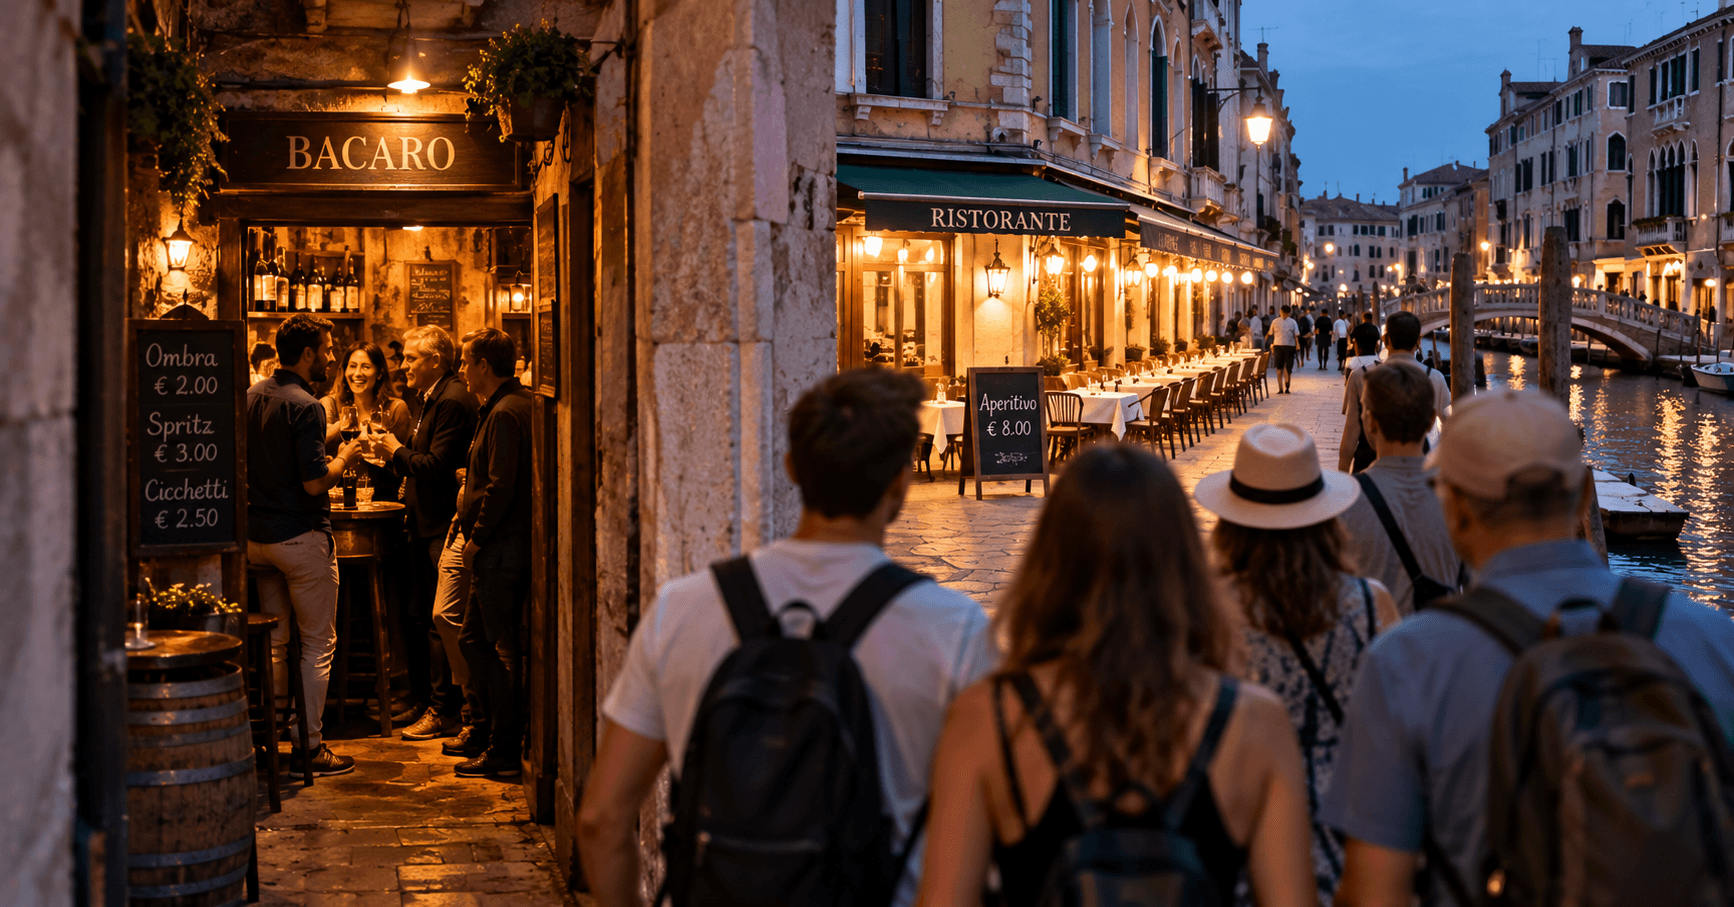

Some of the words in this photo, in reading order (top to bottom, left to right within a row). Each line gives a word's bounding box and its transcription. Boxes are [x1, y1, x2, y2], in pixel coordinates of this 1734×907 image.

[286, 135, 456, 171] BACARO
[930, 207, 1072, 233] RISTORANTE
[145, 342, 219, 368] Ombra
[153, 375, 169, 396] €
[175, 375, 218, 395] 2.00
[979, 393, 1037, 417] Aperitivo
[146, 411, 215, 443] Spritz
[986, 420, 997, 437] €
[1001, 419, 1032, 437] 8.00
[153, 443, 169, 463] €
[175, 442, 218, 463] 3.00
[144, 477, 229, 502] Cicchetti
[154, 509, 169, 530] €
[175, 507, 219, 529] 2.50
